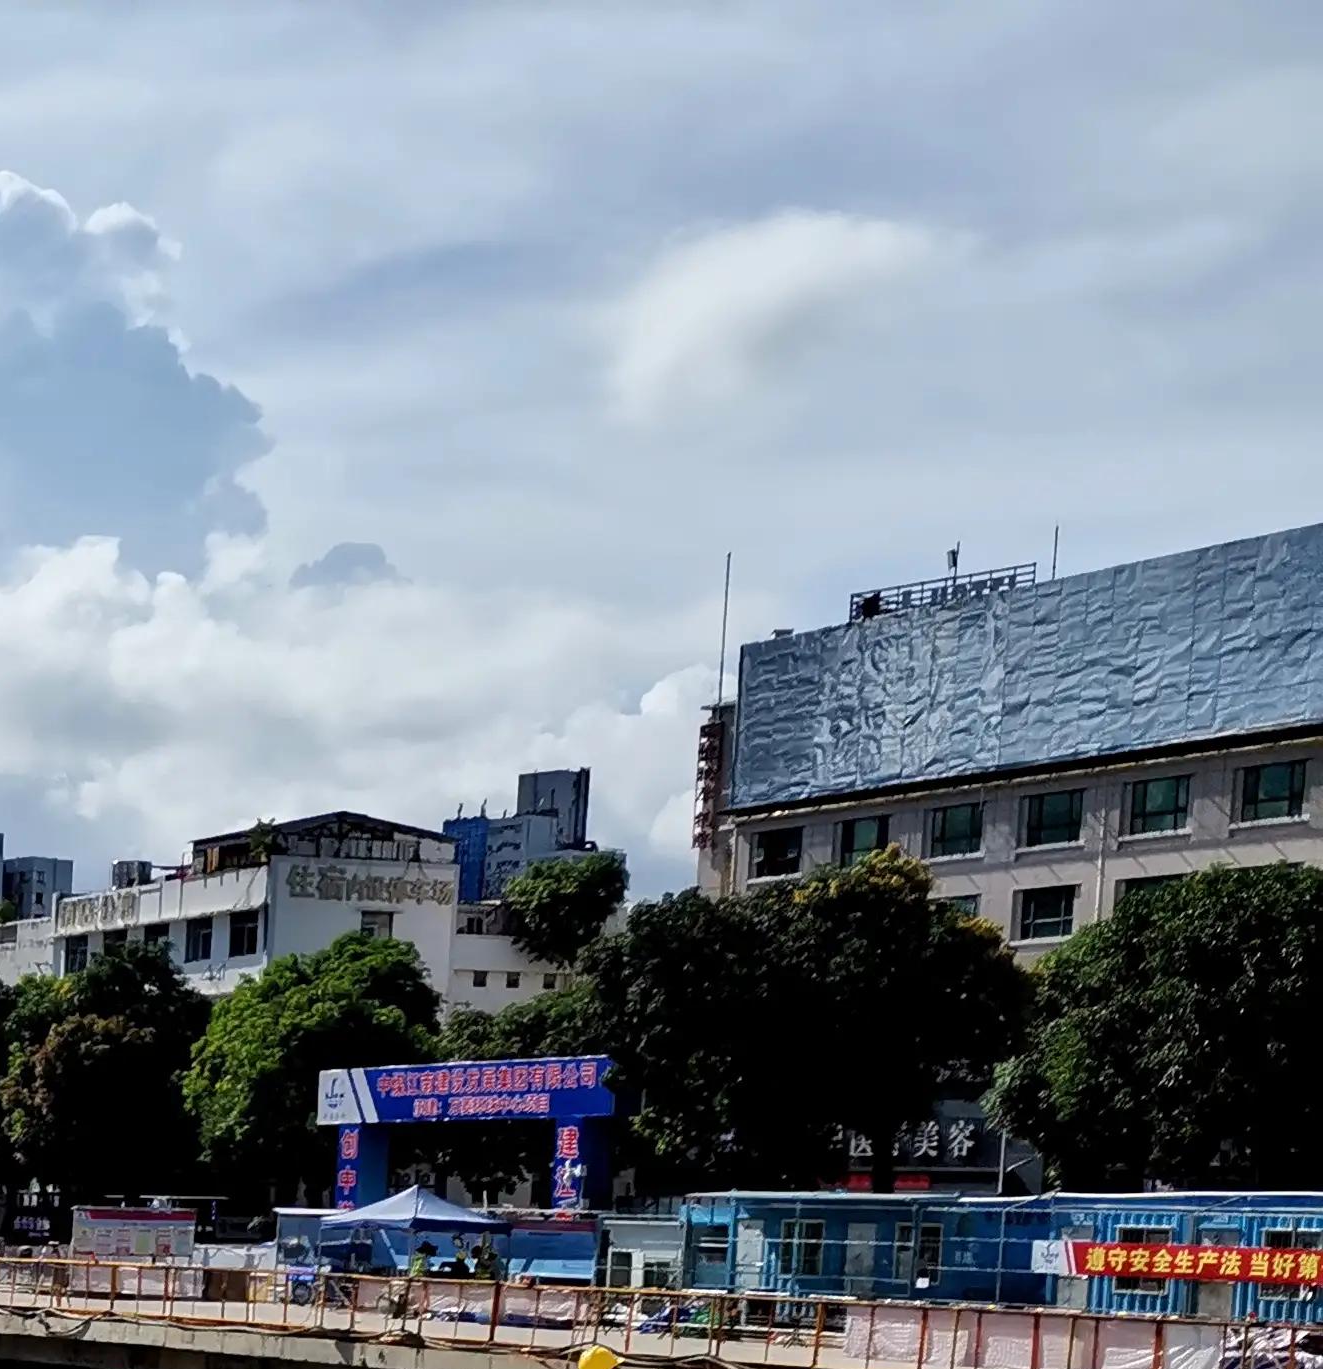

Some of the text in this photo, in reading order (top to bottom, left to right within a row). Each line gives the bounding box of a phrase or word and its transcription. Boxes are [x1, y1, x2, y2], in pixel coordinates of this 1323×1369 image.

[1085, 1246, 1242, 1276] 遵守安全生产法
